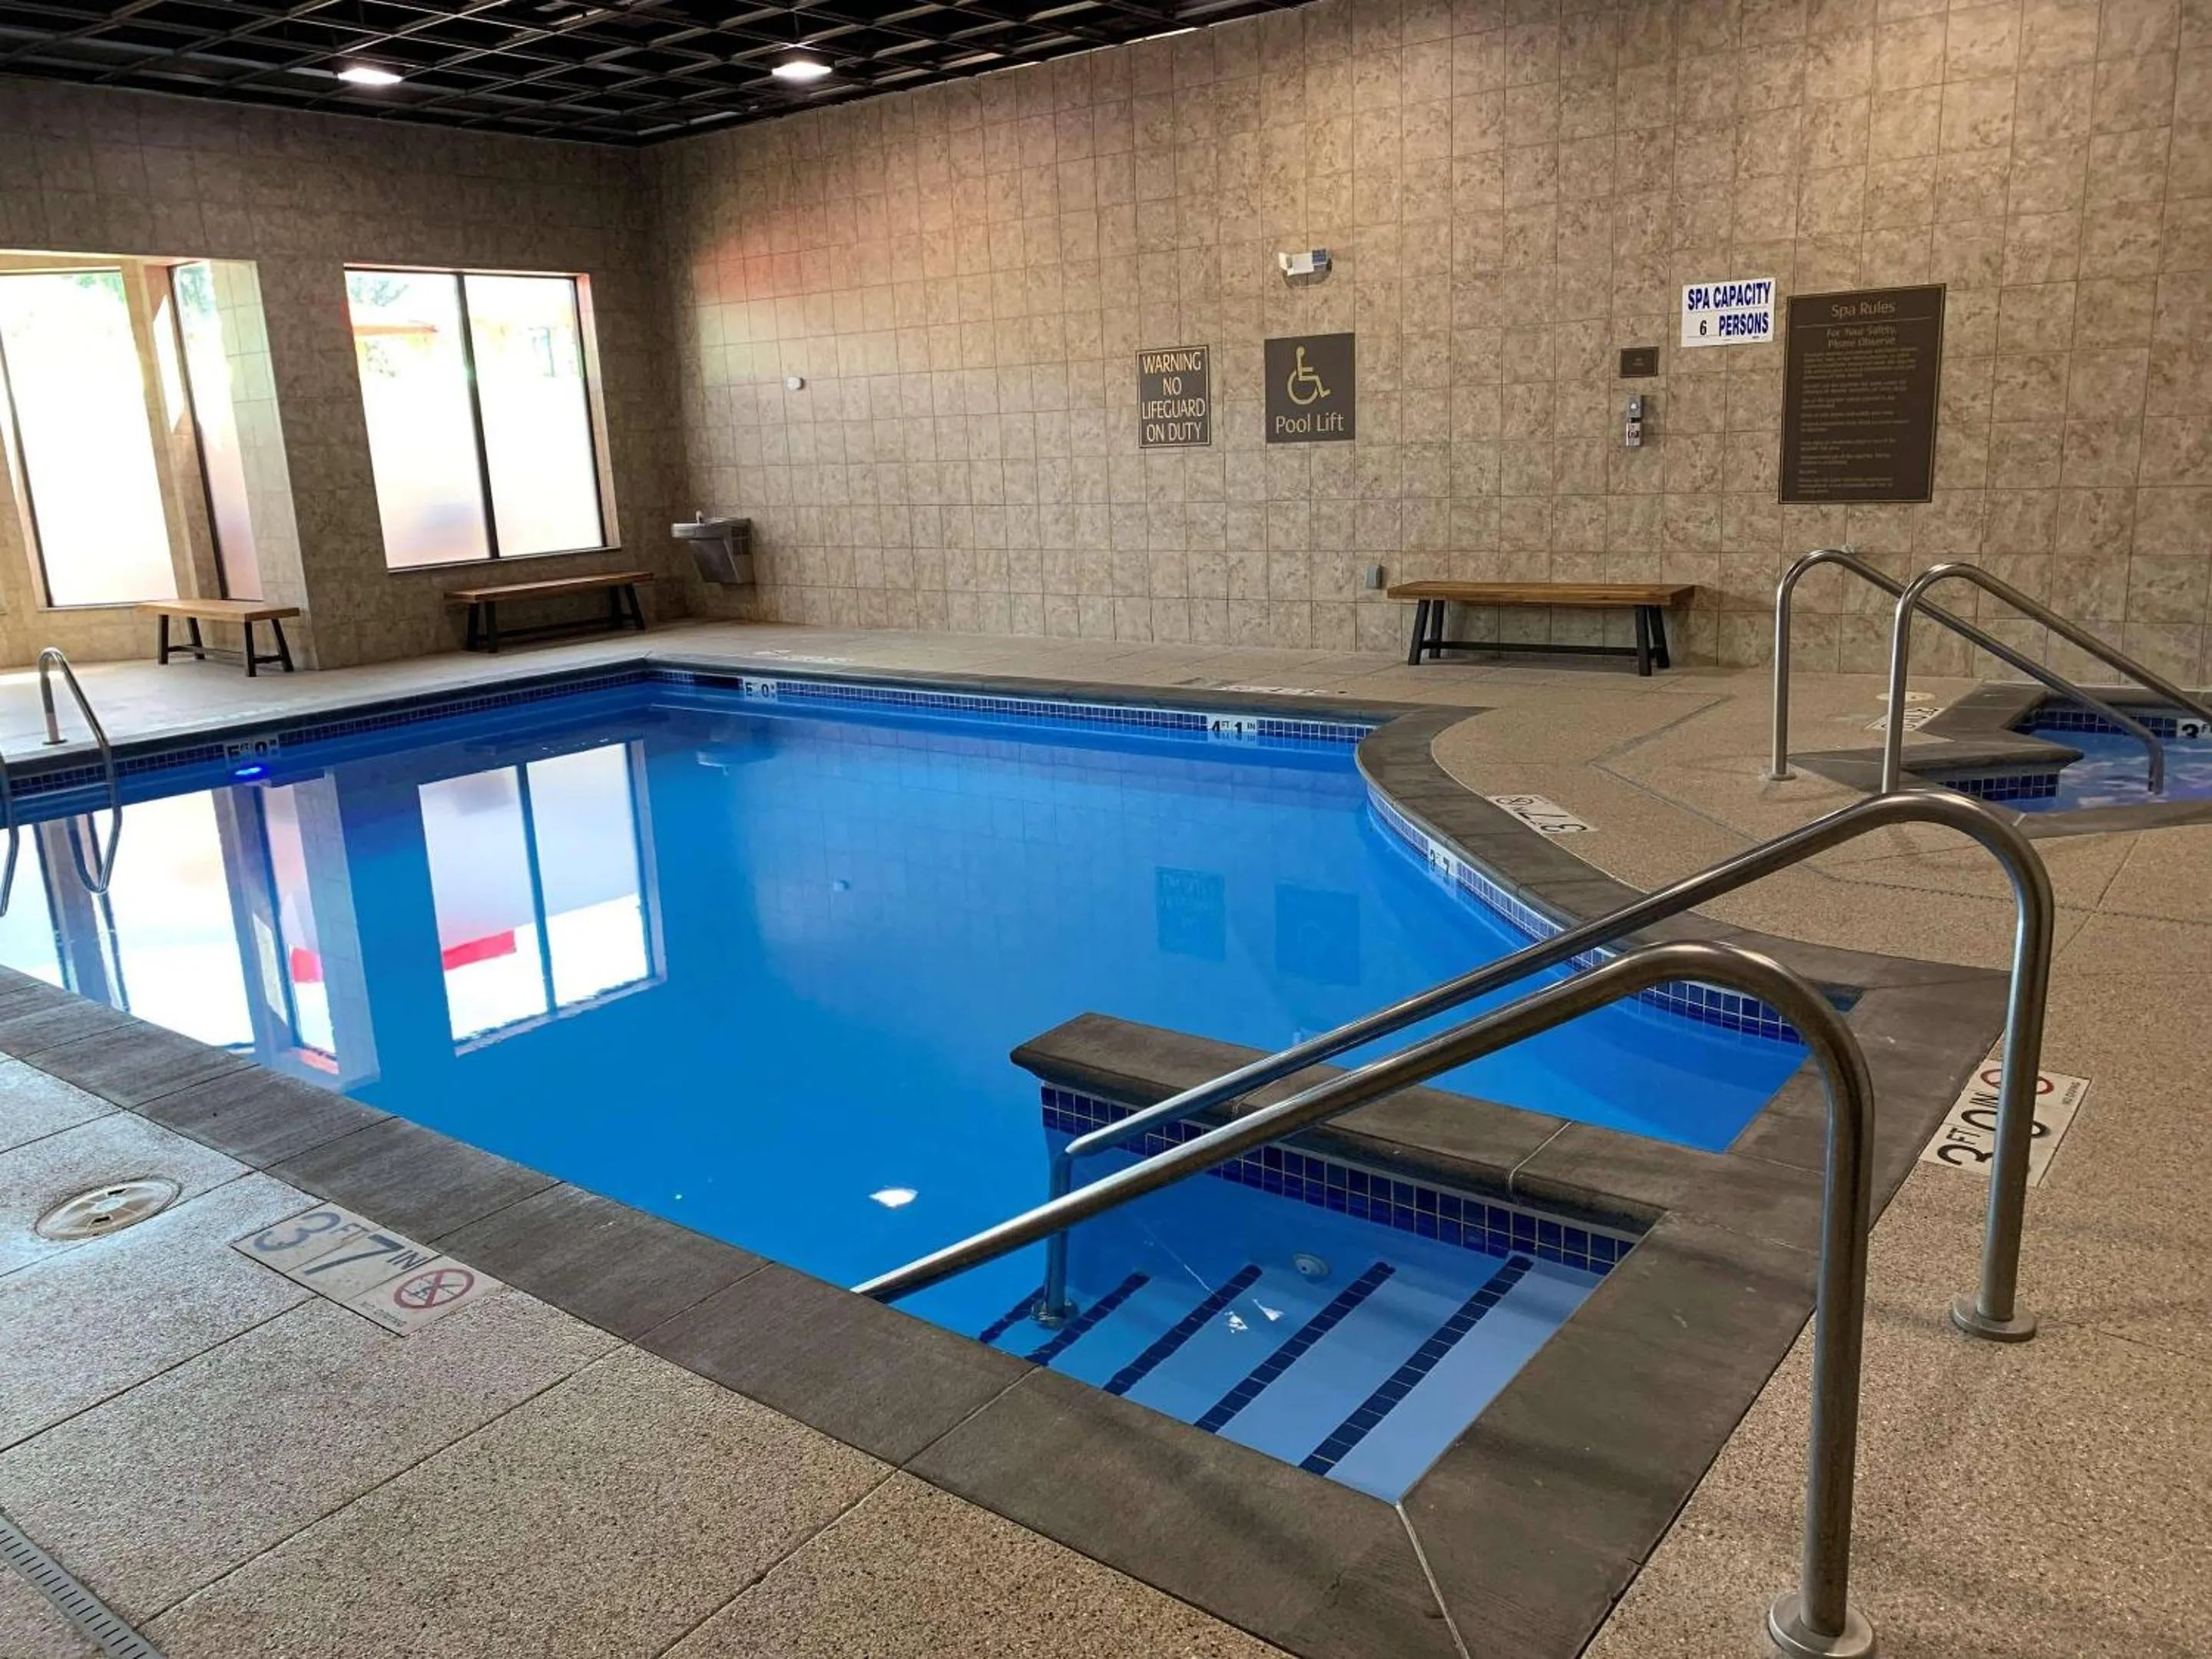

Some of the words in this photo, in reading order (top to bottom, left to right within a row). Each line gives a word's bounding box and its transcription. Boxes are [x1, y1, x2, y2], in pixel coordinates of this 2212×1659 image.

[1687, 287, 1710, 310] SPA
[1713, 281, 1772, 308] CAPACITY
[1831, 304, 1856, 319] Spa
[1859, 300, 1896, 315] Rules
[1699, 320, 1707, 336] 6
[1718, 312, 1770, 336] PERSONS
[1142, 352, 1201, 374] WARNING
[1162, 377, 1182, 396] NO
[1142, 398, 1206, 419] LIFEGUARD
[1146, 423, 1165, 443] ON
[1168, 422, 1202, 442] DUTY
[1275, 415, 1311, 434] Pool
[1316, 412, 1344, 432] Lift
[1540, 823, 1588, 833] 3
[1945, 1127, 1981, 1145] FT
[253, 1210, 341, 1252] 3
[304, 1233, 406, 1277] 7
[386, 1250, 429, 1270] IN
